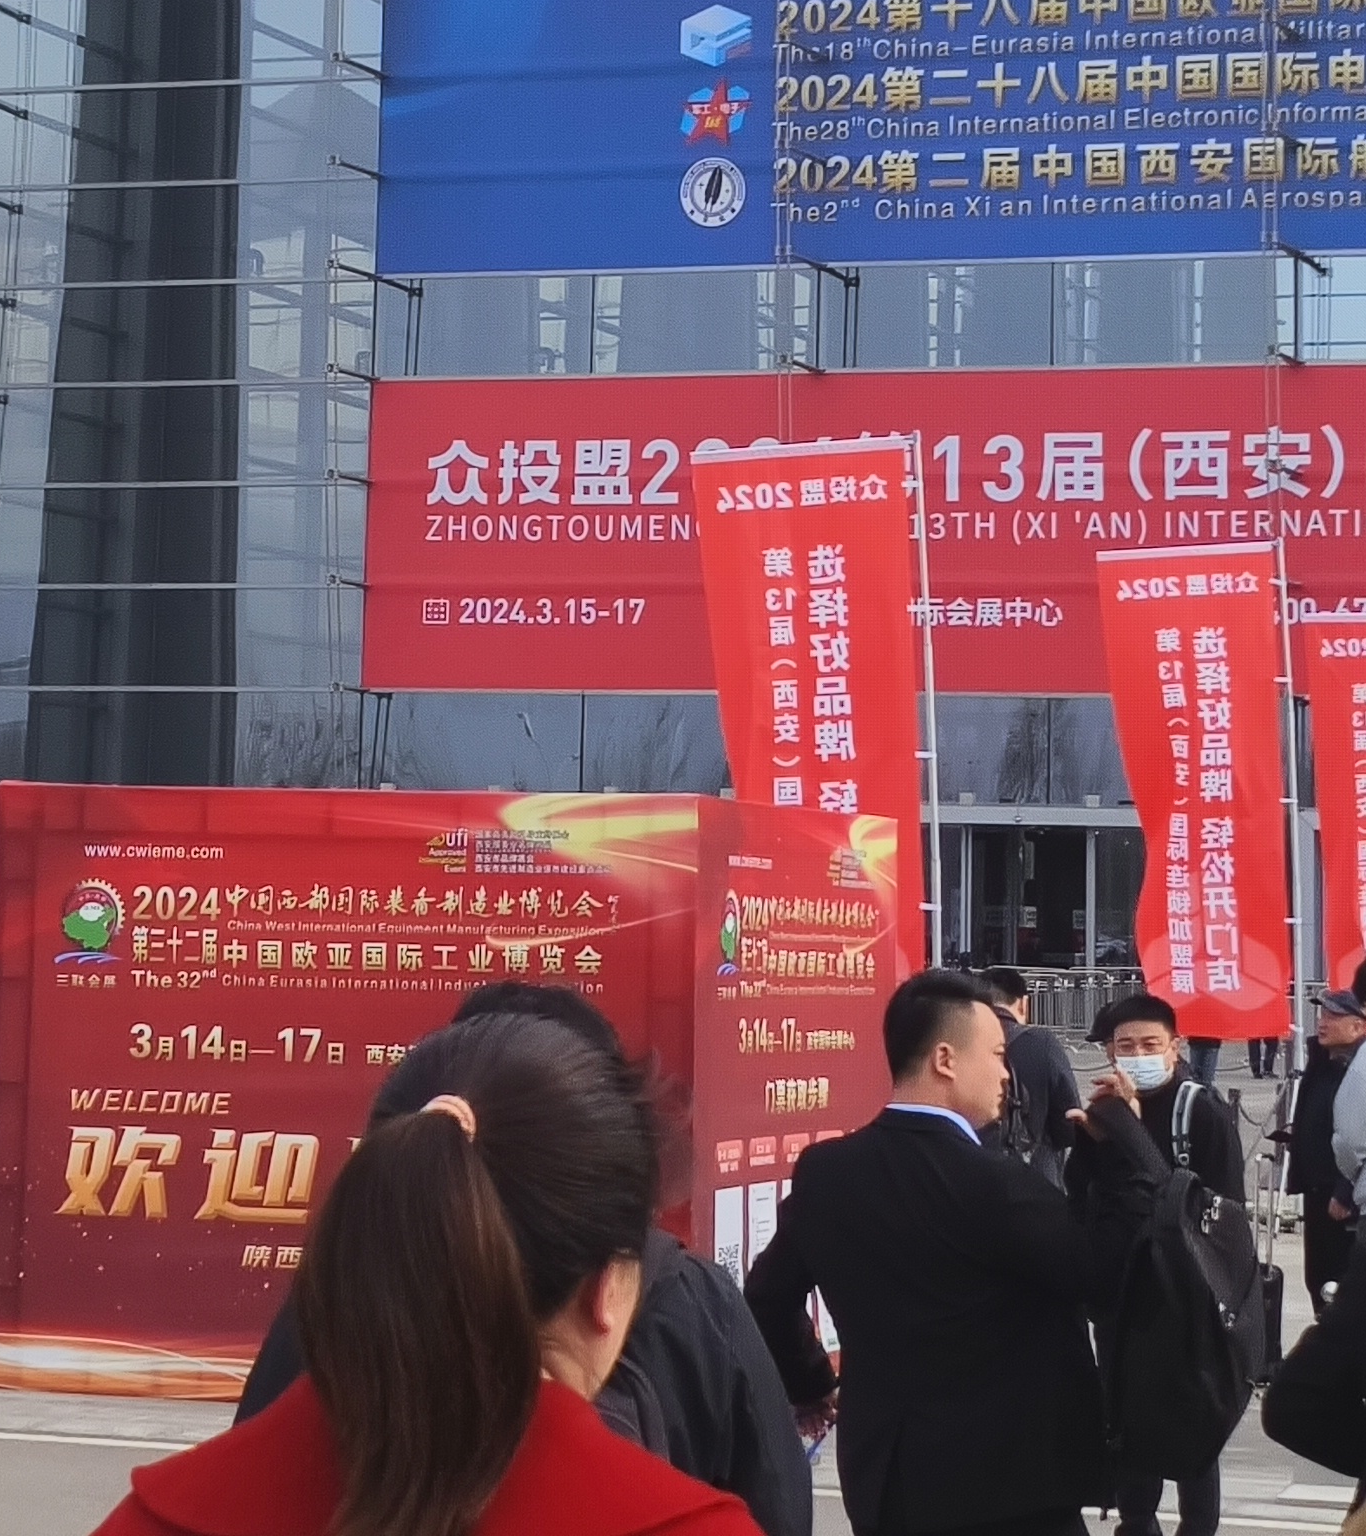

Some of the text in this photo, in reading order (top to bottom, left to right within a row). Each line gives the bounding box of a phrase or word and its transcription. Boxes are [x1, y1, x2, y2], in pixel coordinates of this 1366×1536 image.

[1084, 22, 1266, 51] International
[948, 108, 1116, 136] International
[1124, 103, 1259, 131] Electronic
[874, 197, 955, 220] China
[1042, 188, 1232, 215] International
[424, 514, 701, 541] ZHONGTOUMEN
[458, 597, 646, 624] 2024.3.15-17
[445, 827, 469, 848] ufi
[84, 843, 225, 860] www.cwieme.com
[132, 885, 221, 922] 2024
[227, 919, 606, 938] China West International Equipment Manufacturing Exposition
[132, 925, 603, 975] 第三十二届 中国欧亚国际工业博览会
[56, 973, 117, 989] 三联会展
[130, 969, 173, 989] The
[177, 967, 217, 990] 32nd
[221, 973, 266, 987] China
[269, 974, 328, 989] Eurasia
[332, 975, 436, 992] International
[69, 1088, 232, 1115] WELCOME
